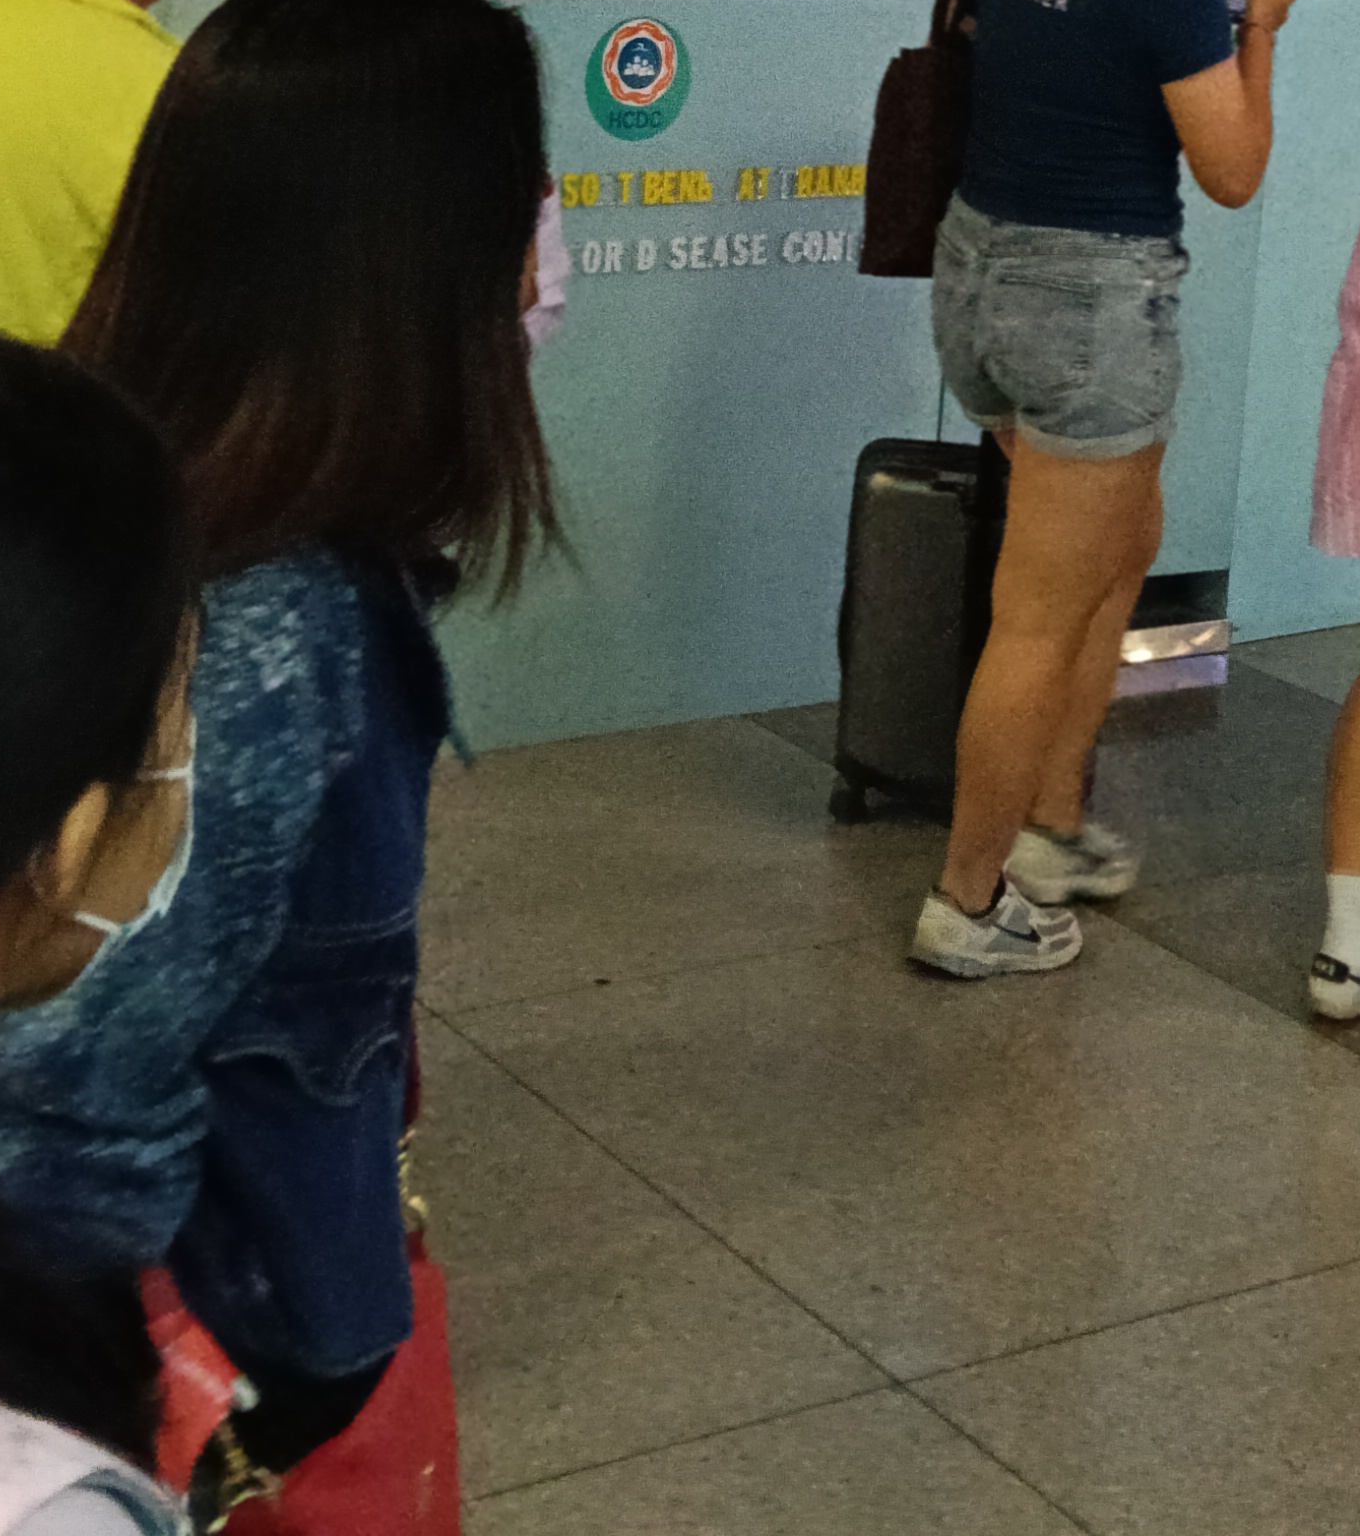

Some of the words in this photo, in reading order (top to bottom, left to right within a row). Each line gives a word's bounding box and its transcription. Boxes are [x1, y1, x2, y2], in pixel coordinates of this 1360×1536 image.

[609, 110, 662, 129] HCDC
[581, 239, 623, 273] OR
[637, 233, 769, 270] DSEASE
